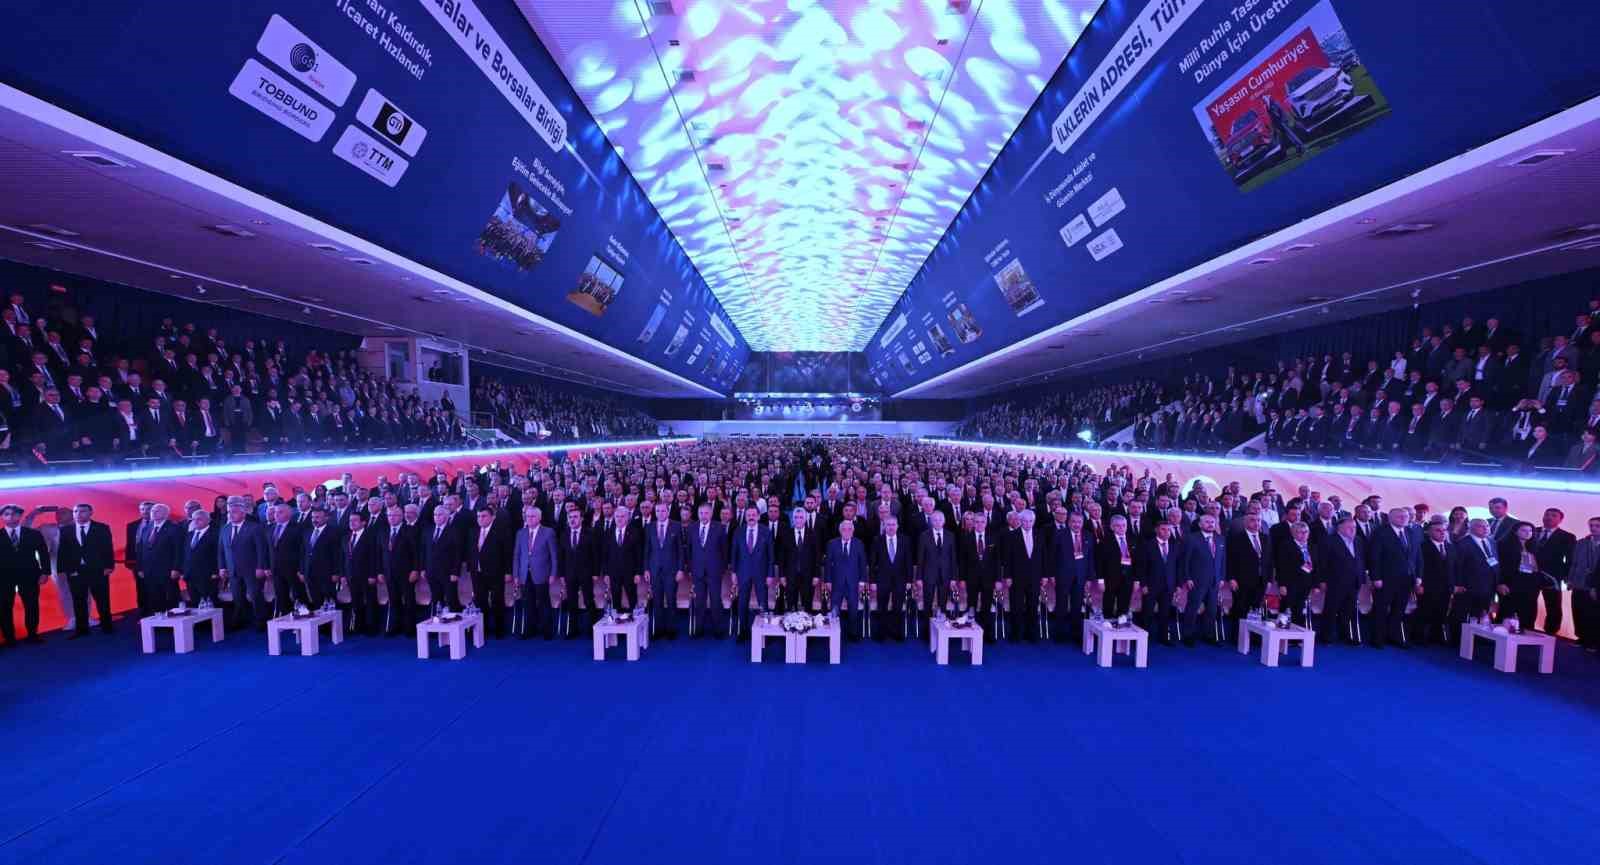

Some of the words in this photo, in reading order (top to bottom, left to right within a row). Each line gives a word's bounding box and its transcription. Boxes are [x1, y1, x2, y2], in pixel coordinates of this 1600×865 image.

[379, 32, 425, 80] Hızlandı!
[387, 12, 432, 67] Kaldırdık,
[1194, 50, 1229, 83] Dünya
[1226, 30, 1250, 53] İçin
[1200, 20, 1232, 54] Ruhla
[301, 55, 319, 73] GS1
[475, 32, 491, 60] ve
[491, 50, 536, 113] Borsalar
[536, 104, 563, 144] Birliği
[1055, 85, 1101, 145] İLKLERİN
[1100, 25, 1153, 96] ADRESİ,
[1211, 86, 1249, 117] Yaşasın
[1248, 39, 1310, 90] Cumhuriyet
[259, 77, 318, 121] TOBBUND
[369, 147, 394, 171] TTM
